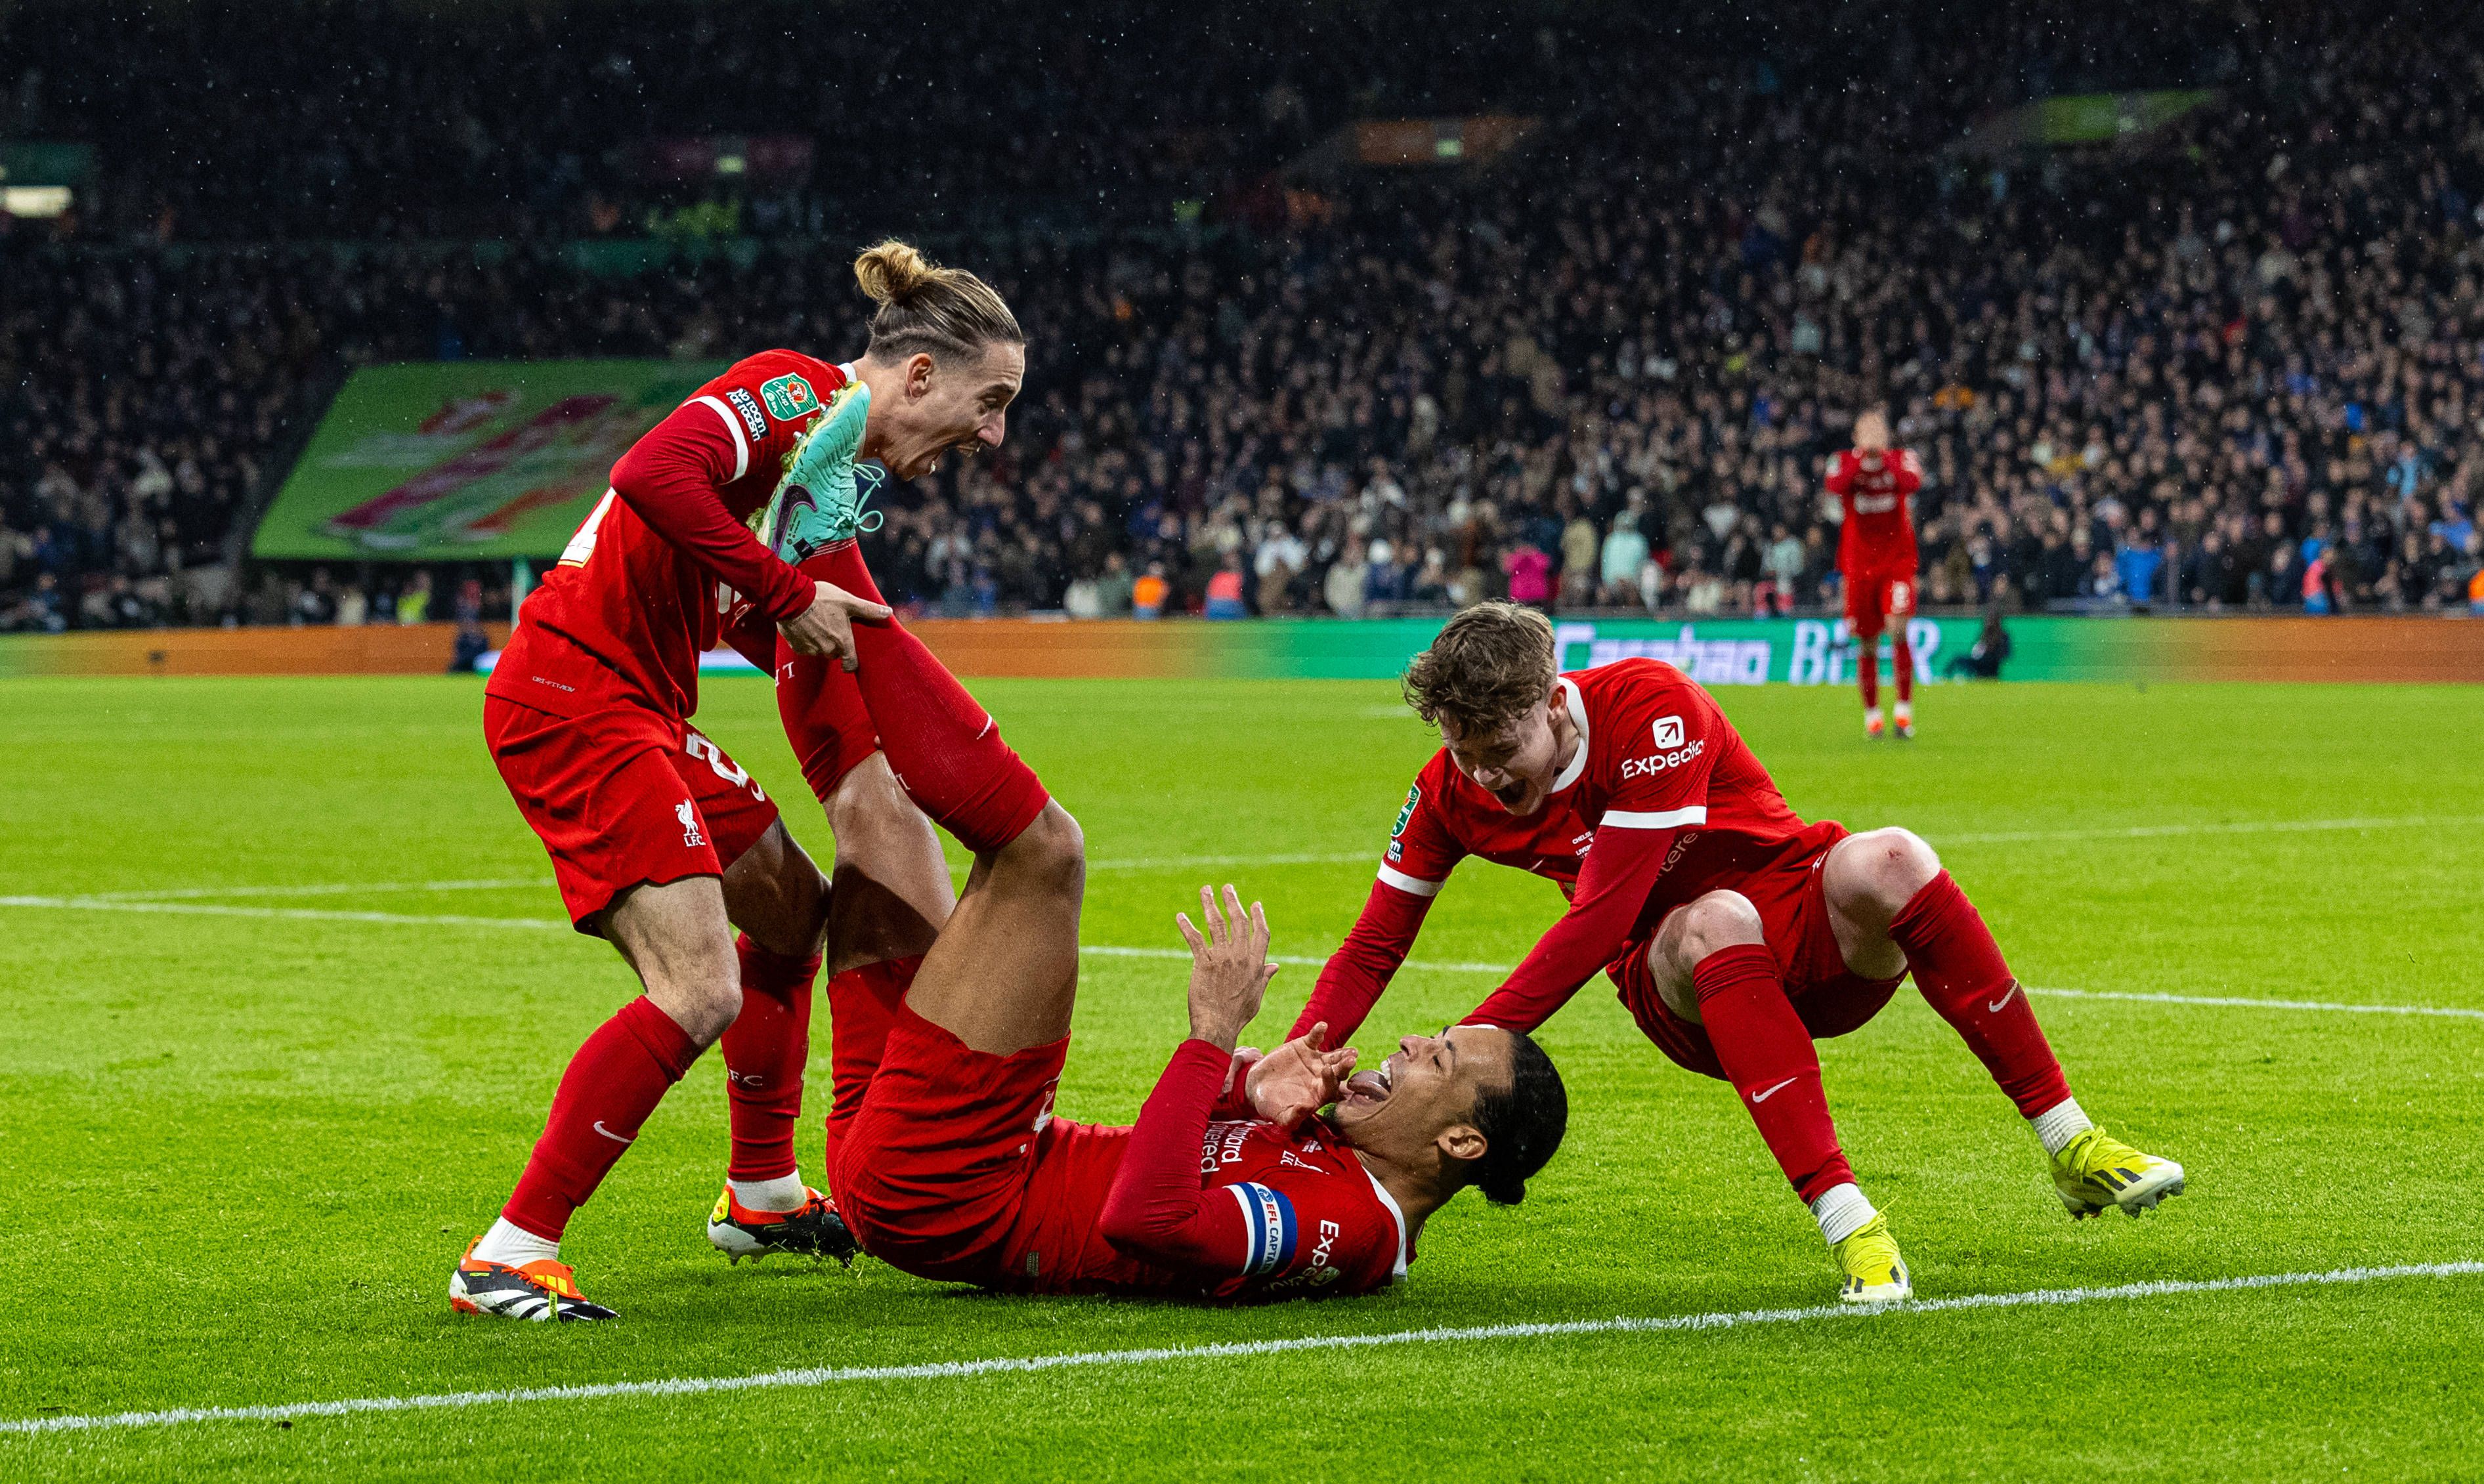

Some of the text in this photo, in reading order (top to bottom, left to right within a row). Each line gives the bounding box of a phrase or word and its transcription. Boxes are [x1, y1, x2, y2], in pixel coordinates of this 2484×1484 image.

[737, 388, 767, 434] No room
[775, 389, 790, 407] Cup
[725, 391, 761, 442] for racism
[1266, 1203, 1277, 1224] EFL
